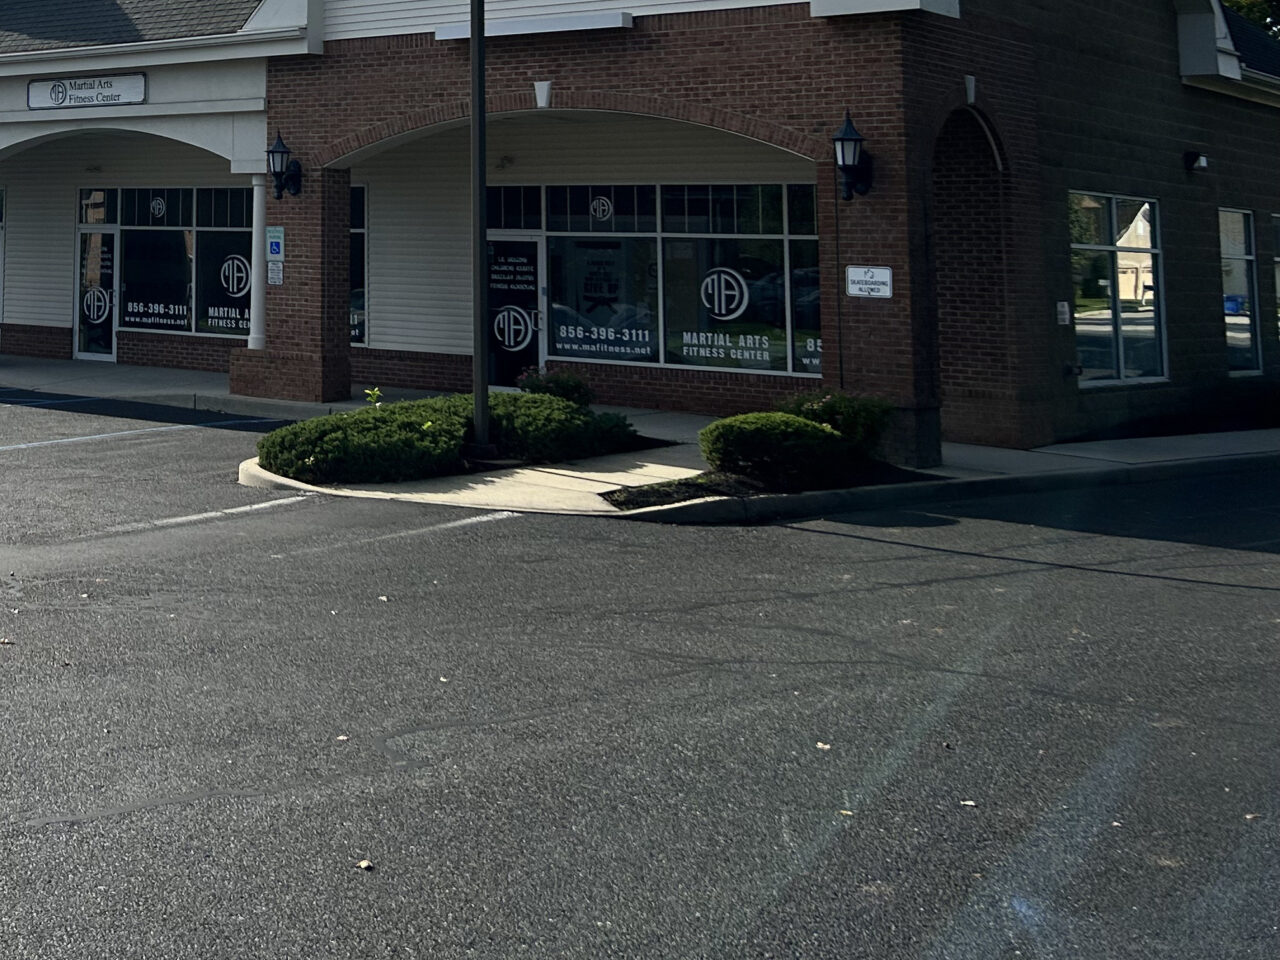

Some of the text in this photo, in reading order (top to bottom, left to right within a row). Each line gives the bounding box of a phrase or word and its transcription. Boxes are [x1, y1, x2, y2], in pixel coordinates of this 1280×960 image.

[69, 80, 113, 91] Martial Arts
[69, 92, 121, 104] Fitness Center
[127, 302, 187, 315] 856-396-3111
[208, 306, 240, 319] MARTIAL
[208, 319, 236, 328] FITNESS
[560, 326, 649, 342] 856-396-3111
[683, 331, 769, 349] MARTIAL ARTS
[556, 343, 651, 354] www.mafitness.net
[683, 347, 770, 361] FITNESS CENTER
